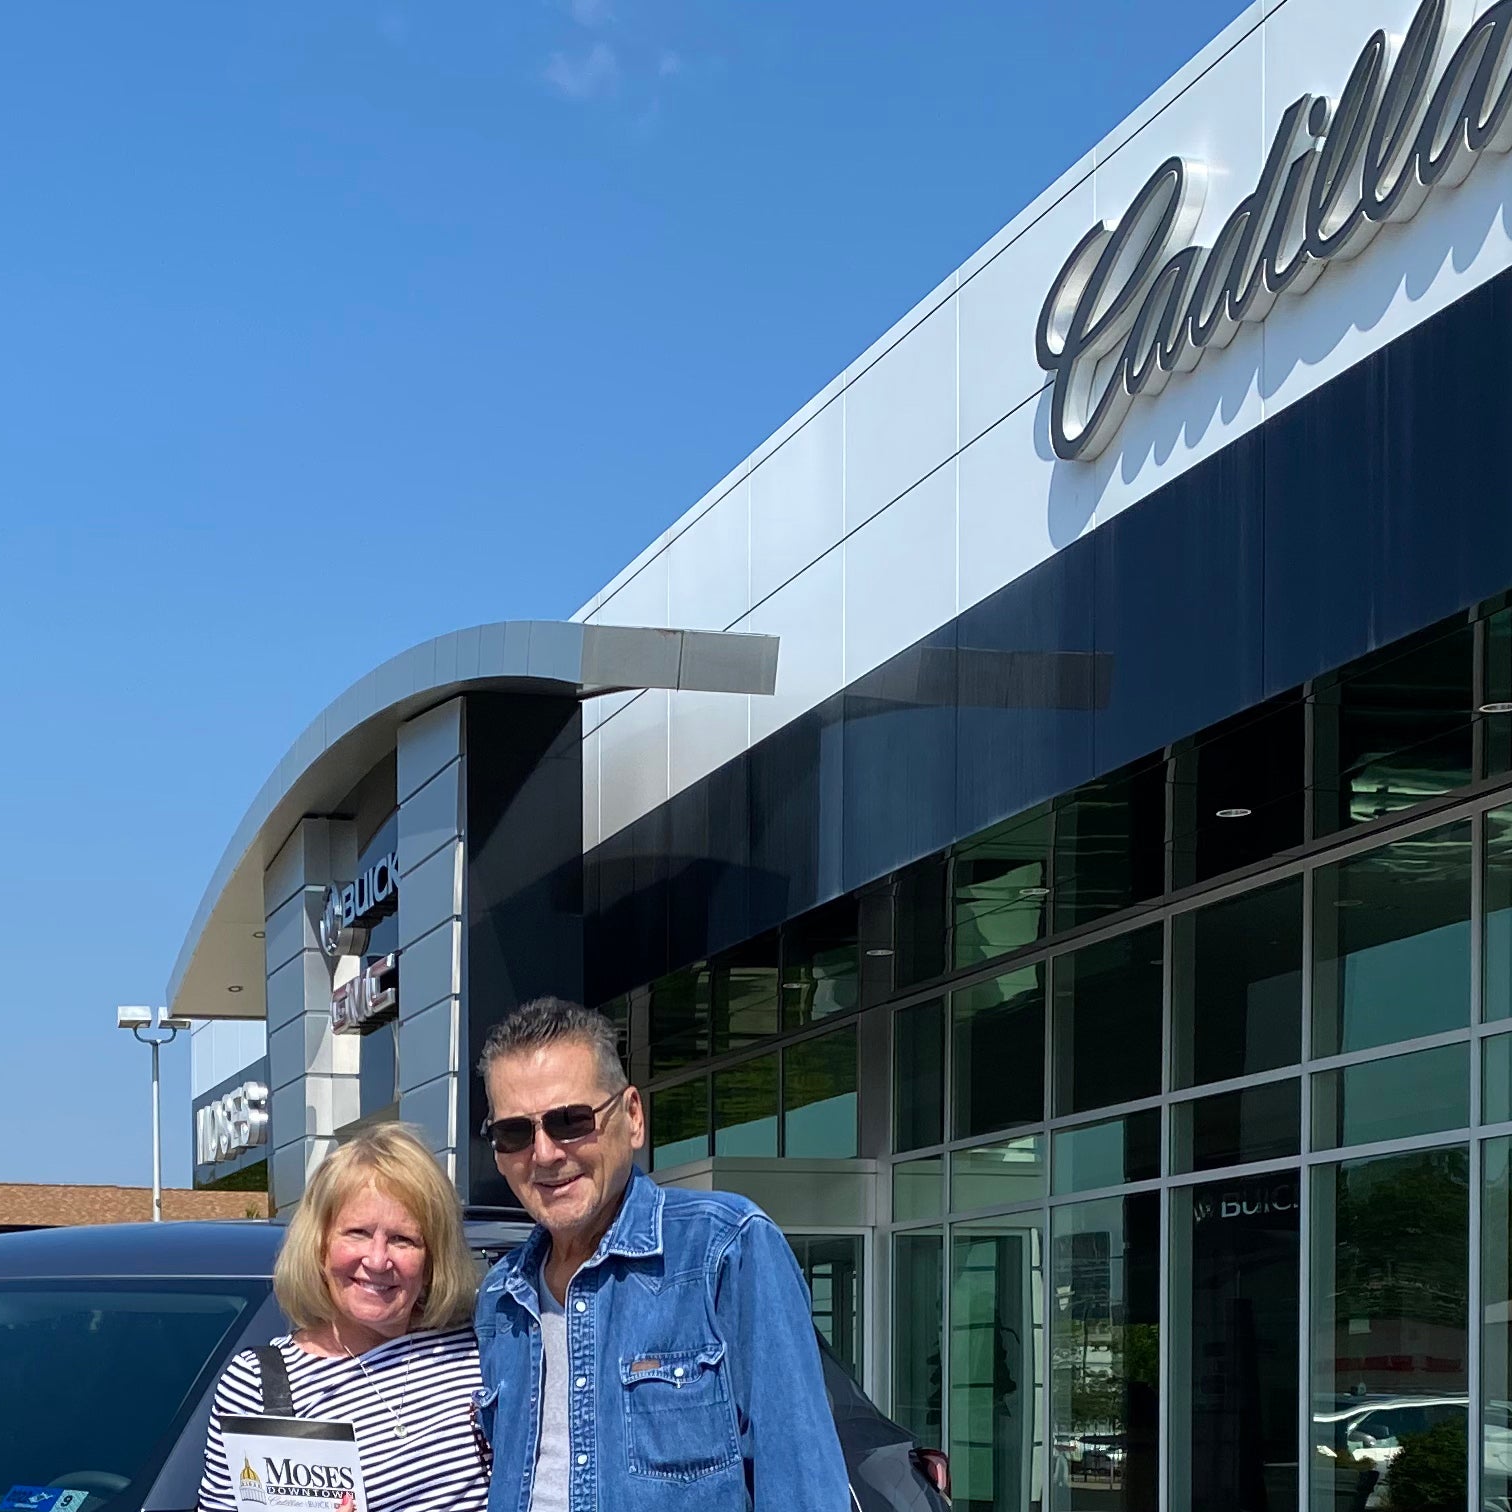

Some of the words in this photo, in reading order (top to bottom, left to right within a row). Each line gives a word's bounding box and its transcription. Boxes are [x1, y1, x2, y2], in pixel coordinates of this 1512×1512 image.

[341, 851, 399, 929] BUICK
[264, 1457, 355, 1489] MOSES
[60, 1494, 73, 1507] 9
[267, 1486, 354, 1500] DOWNTOWN
